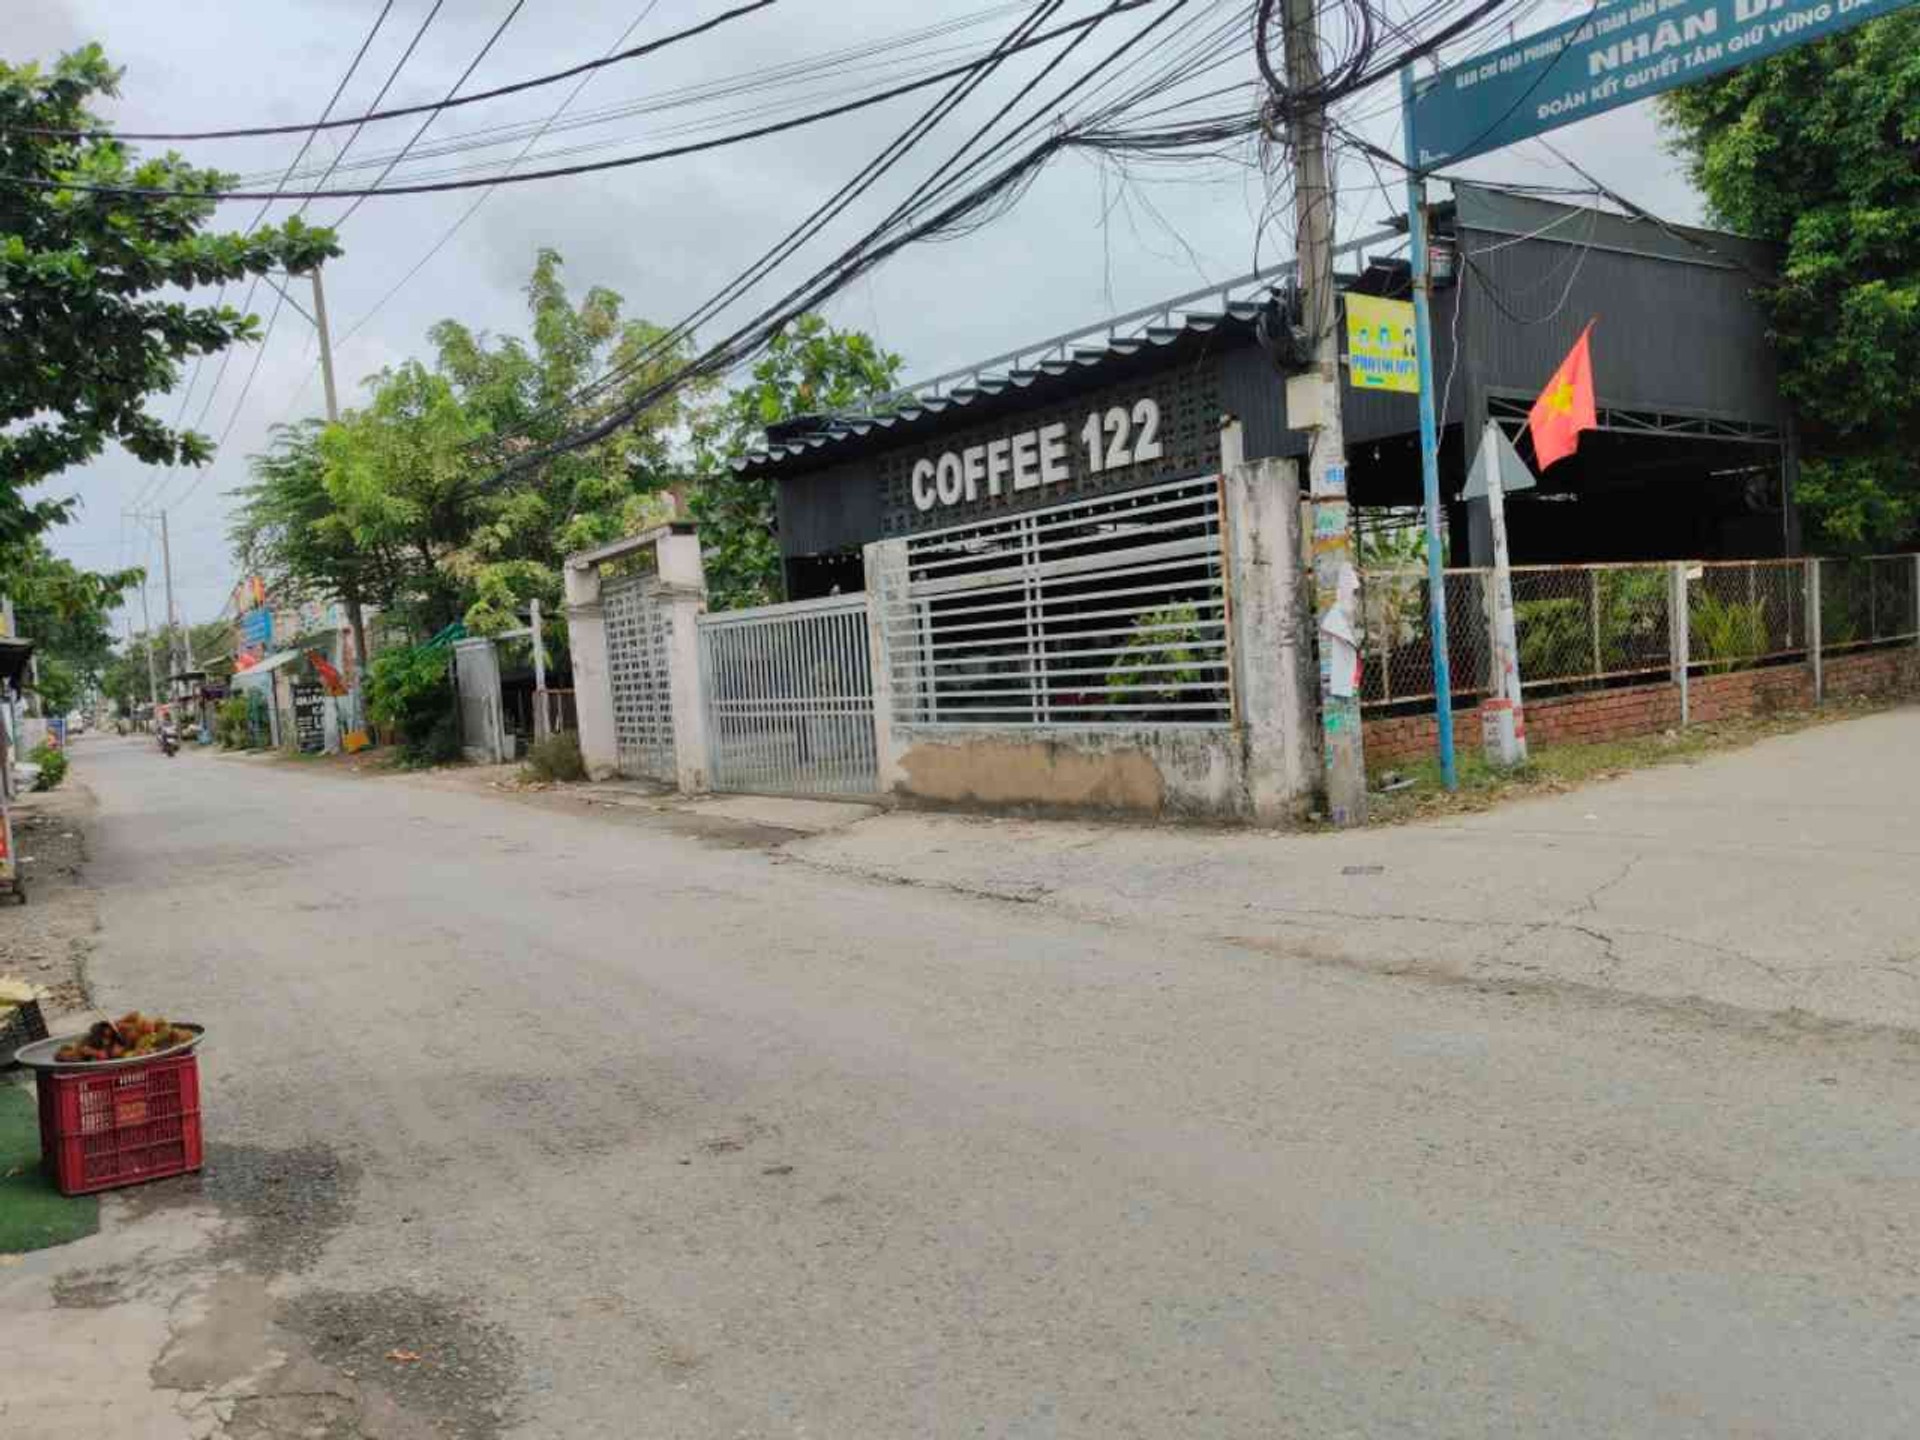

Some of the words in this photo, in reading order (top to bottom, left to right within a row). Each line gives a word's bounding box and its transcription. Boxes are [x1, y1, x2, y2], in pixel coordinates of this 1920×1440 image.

[1682, 43, 1724, 69] TÂM
[912, 421, 1069, 511] COFFEE
[1081, 398, 1163, 472] 122
